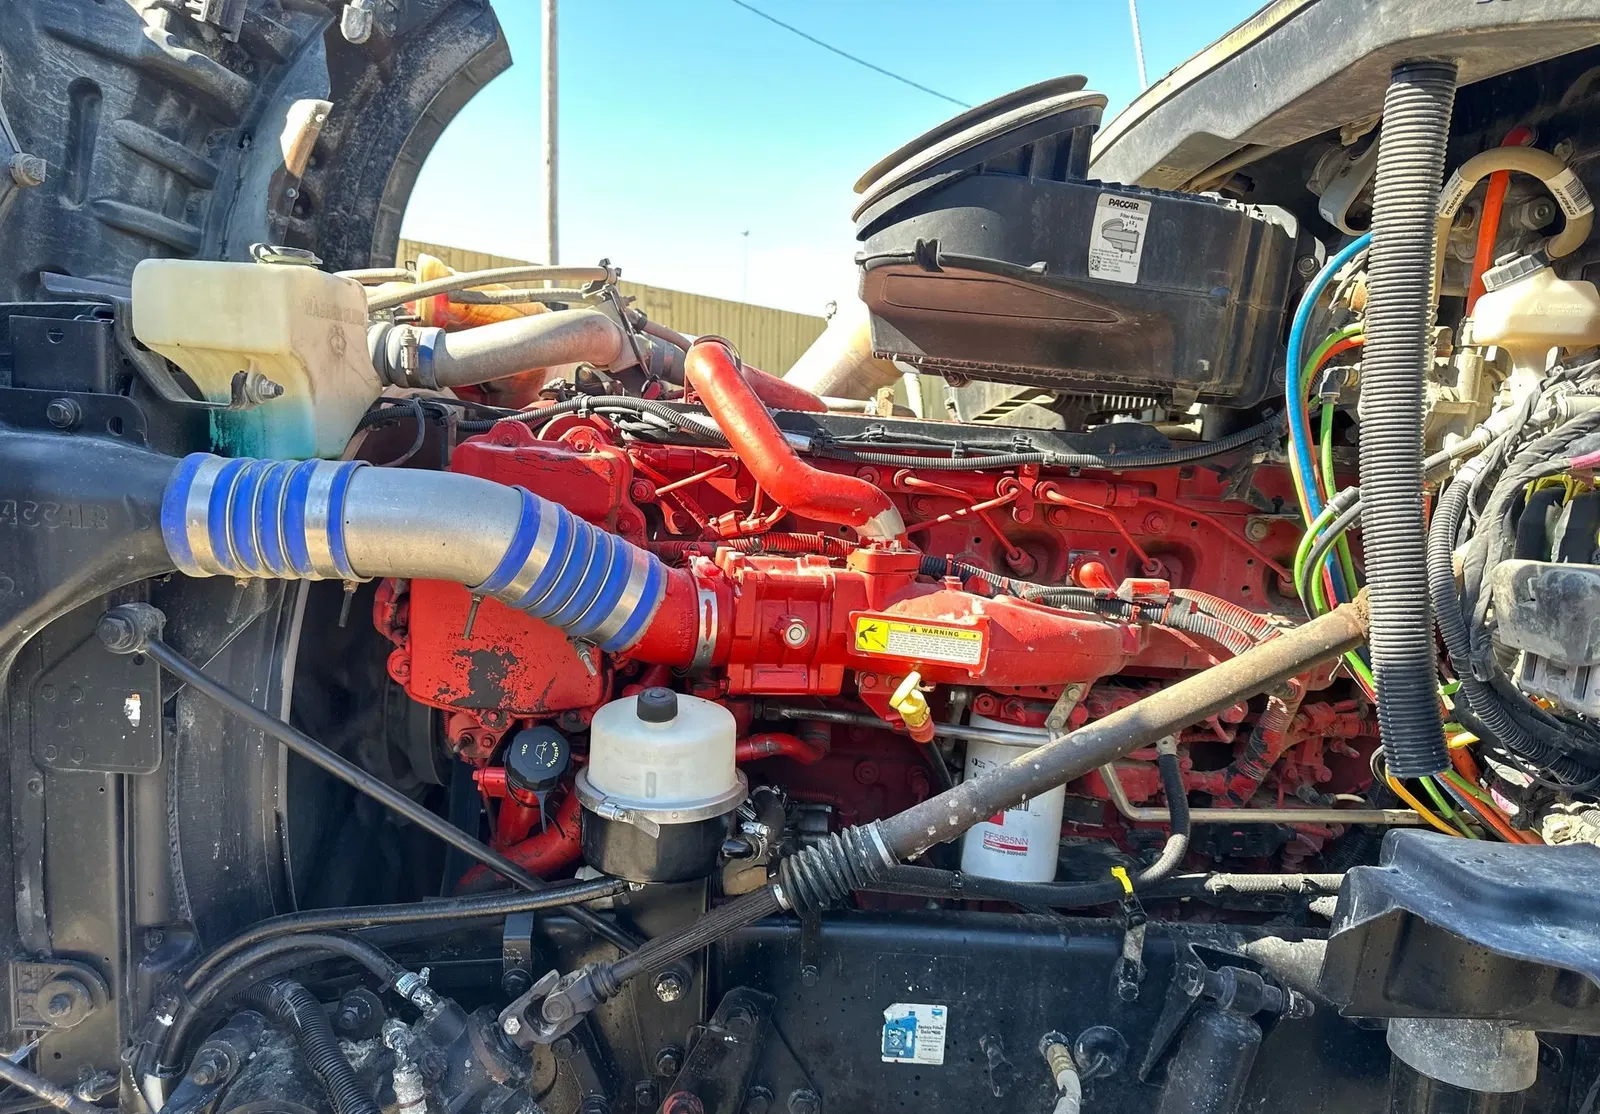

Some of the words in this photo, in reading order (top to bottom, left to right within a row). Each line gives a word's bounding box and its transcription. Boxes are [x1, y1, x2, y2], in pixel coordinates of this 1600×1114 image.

[1108, 198, 1139, 210] PACCAR
[0, 499, 109, 529] ACCAR
[921, 627, 959, 637] WARNING
[546, 741, 559, 768] ENGINE
[984, 830, 1029, 846] FF5825NN
[982, 844, 1006, 855] Cummins
